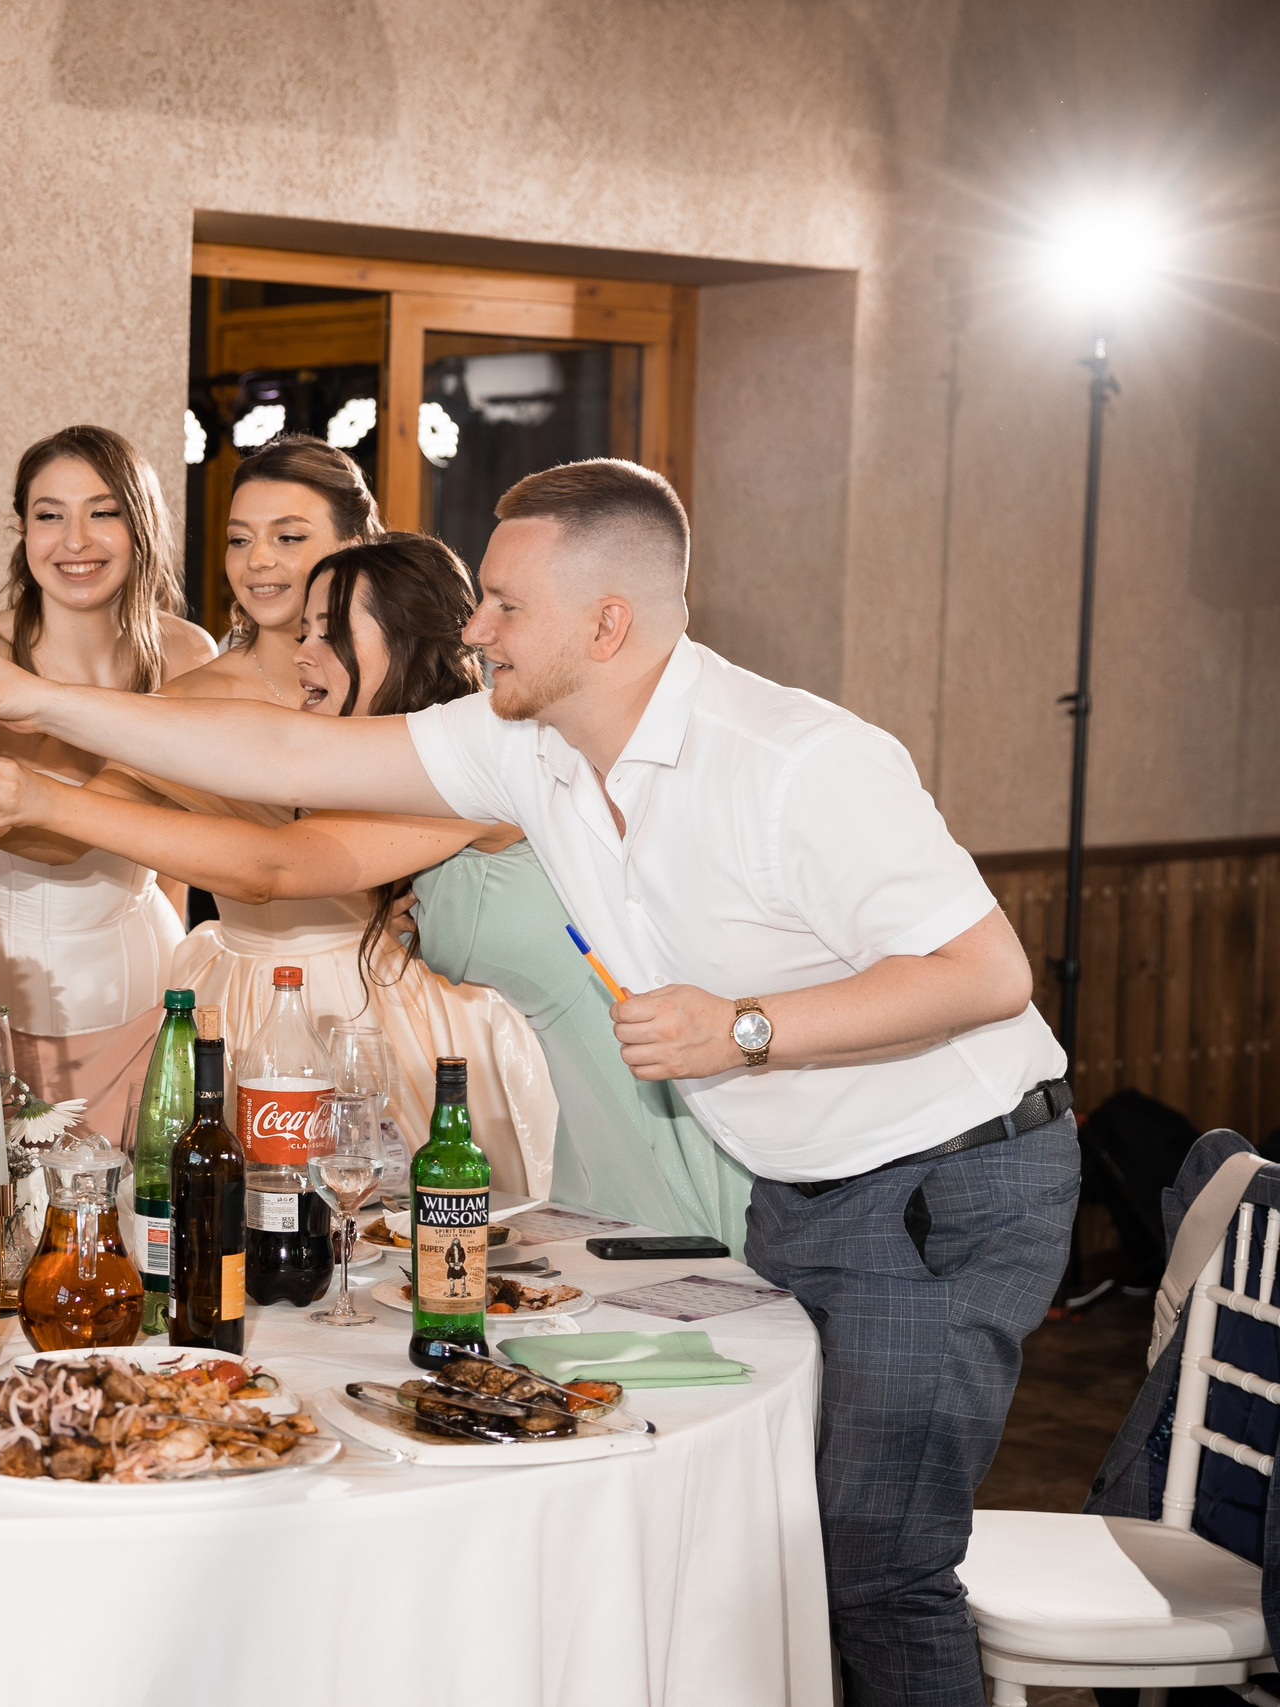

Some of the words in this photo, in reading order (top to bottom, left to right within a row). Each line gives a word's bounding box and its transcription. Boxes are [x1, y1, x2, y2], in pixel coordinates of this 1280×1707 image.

[422, 1195, 486, 1212] WILLIAM
[419, 1208, 488, 1226] LAWSON'S
[419, 1243, 445, 1254] SUPER
